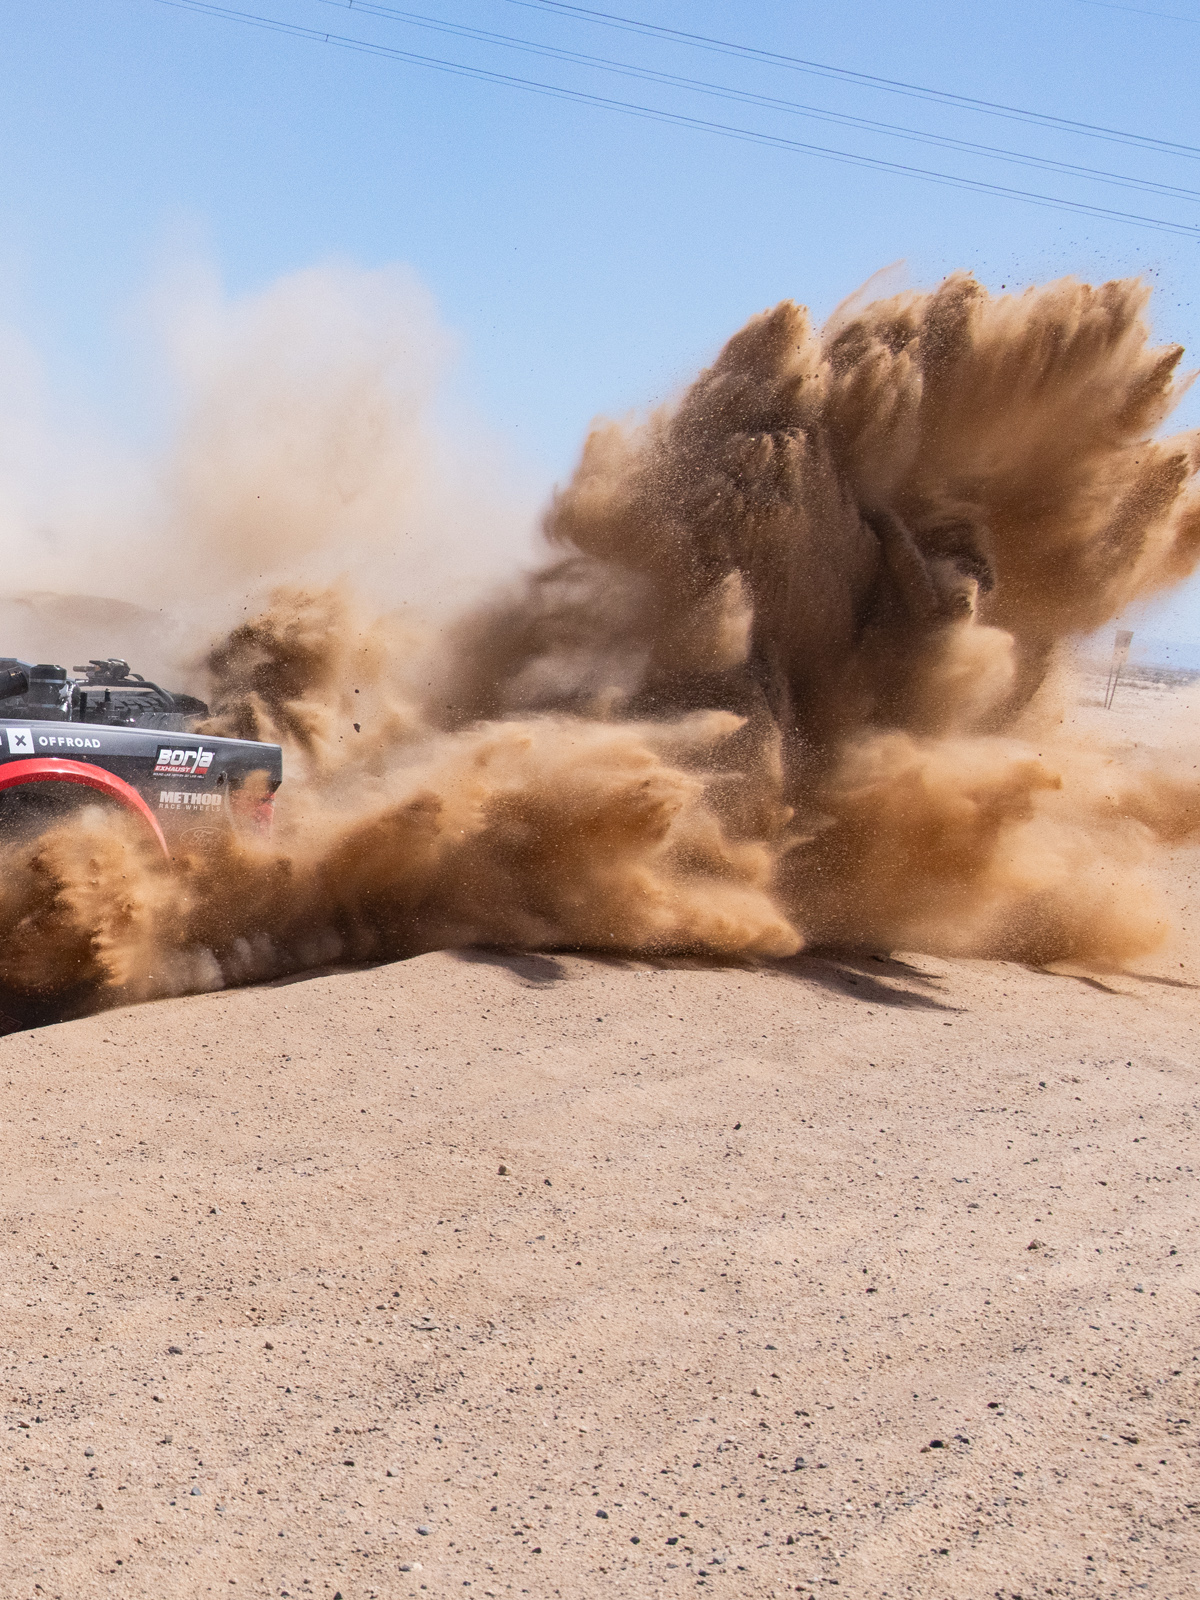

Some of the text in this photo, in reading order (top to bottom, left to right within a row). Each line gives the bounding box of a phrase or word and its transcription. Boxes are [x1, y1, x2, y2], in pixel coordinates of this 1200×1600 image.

[38, 736, 101, 748] OFFROAD
[155, 764, 191, 772] EXHAUST
[160, 790, 222, 806] METHOD
[185, 804, 221, 812] WHEELS
